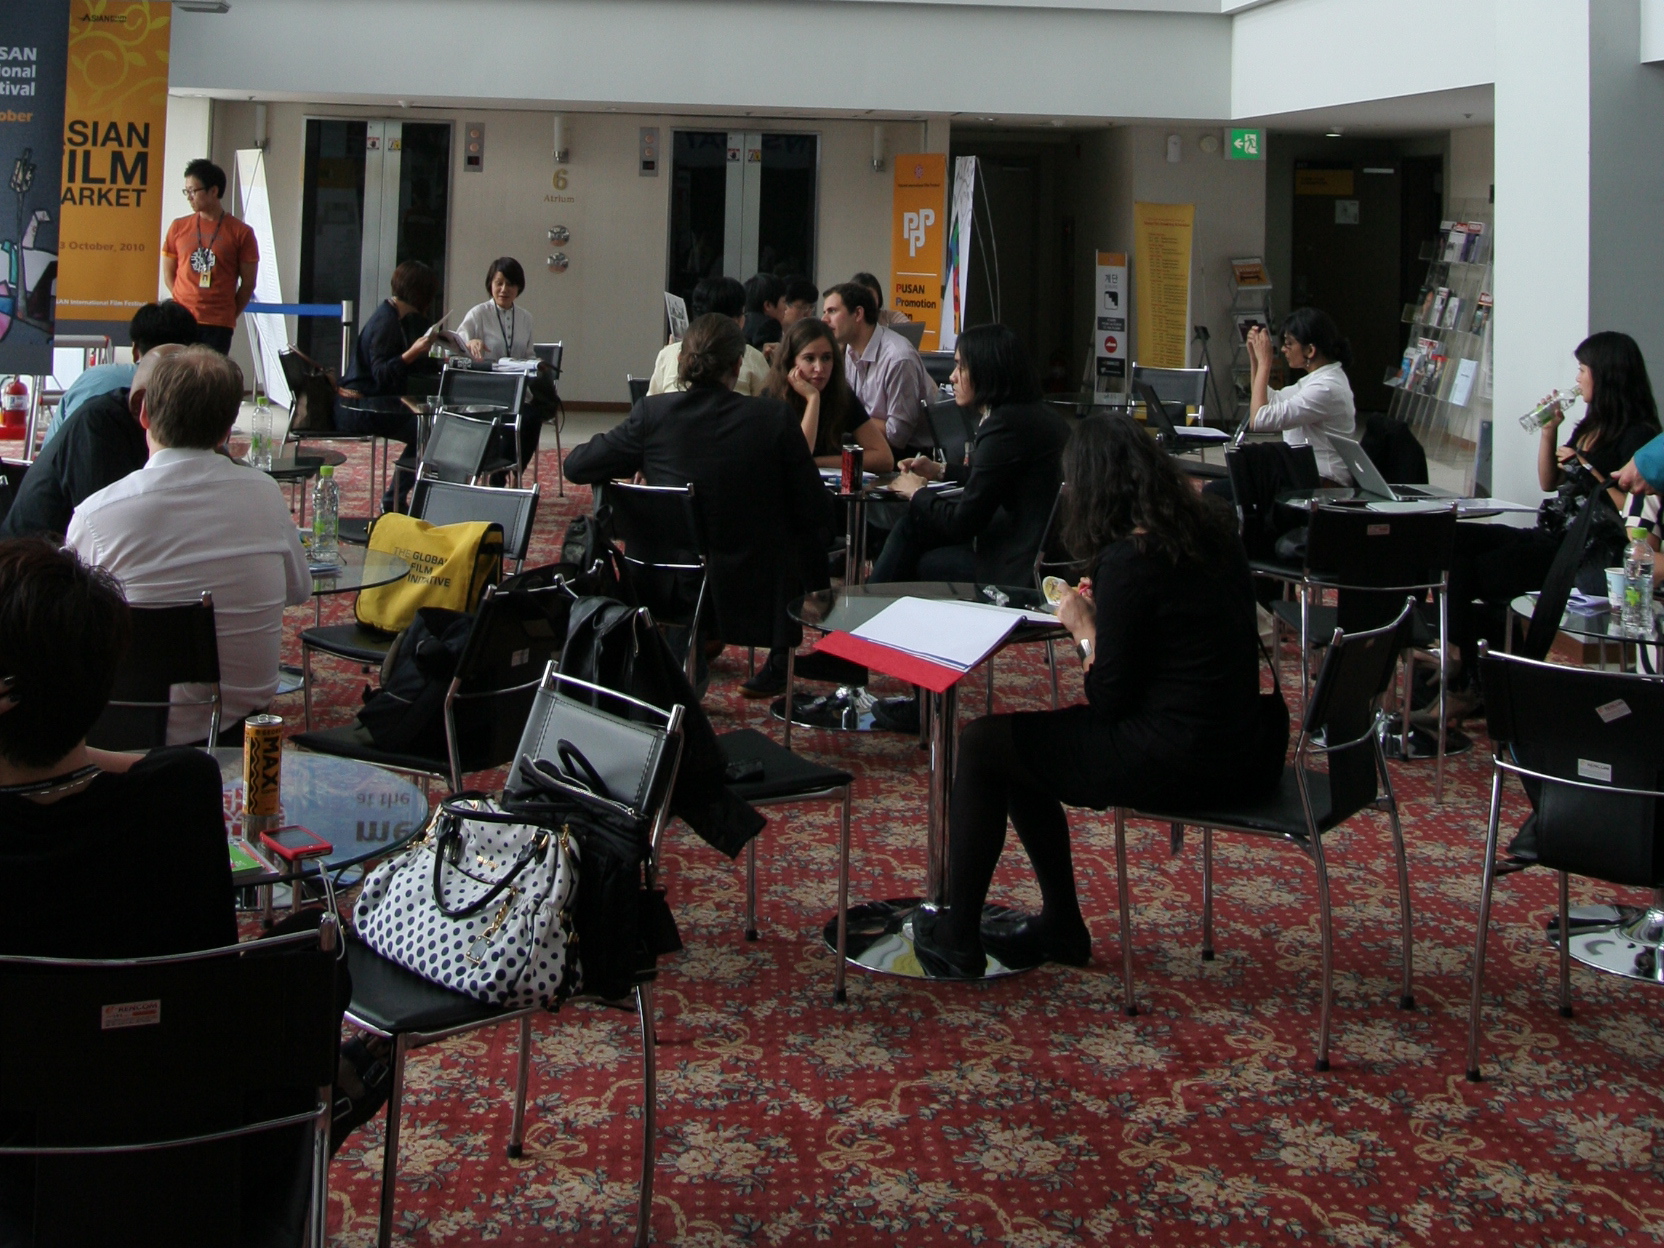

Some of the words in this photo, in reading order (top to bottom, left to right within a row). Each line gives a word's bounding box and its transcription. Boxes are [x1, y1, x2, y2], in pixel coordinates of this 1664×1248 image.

[64, 120, 150, 149] SIAN
[62, 149, 149, 186] ILM
[552, 168, 569, 191] 6
[543, 194, 575, 203] Atrium
[120, 242, 145, 252] 2010
[896, 284, 925, 294] PUSAN
[895, 297, 937, 309] Promotion
[261, 736, 280, 788] MAX
